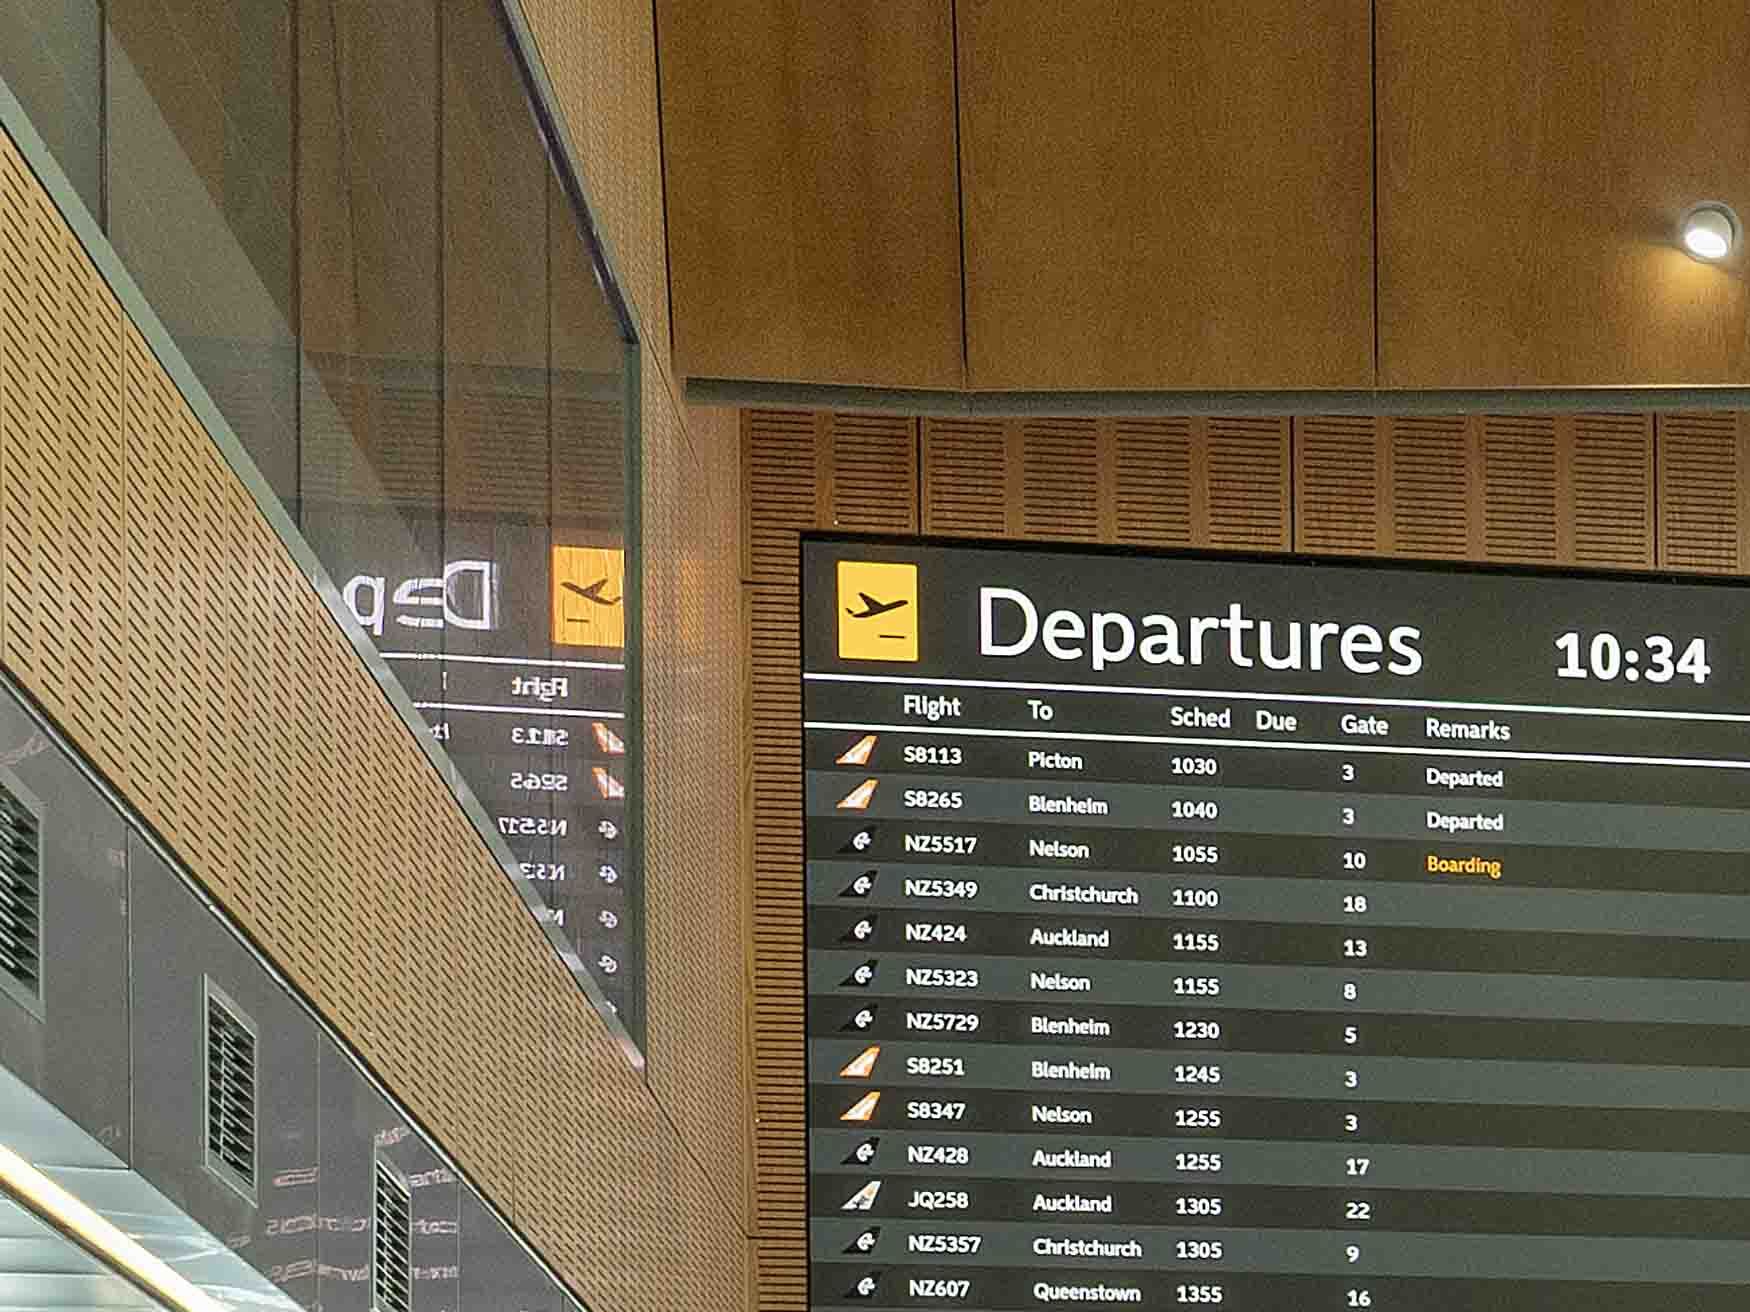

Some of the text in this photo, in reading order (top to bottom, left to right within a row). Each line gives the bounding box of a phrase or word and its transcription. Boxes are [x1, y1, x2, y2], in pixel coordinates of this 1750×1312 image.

[980, 587, 1712, 684] Departures 10:34
[903, 694, 1511, 741] Flight To Sched Due Gate Remarks
[903, 745, 1503, 790] S8113 Picton 1030 3 Departed
[904, 834, 1502, 879] NZ5517 Nelson 1055 10 Boarding
[905, 879, 1367, 913] NZ5349 Christchurch 1100 18
